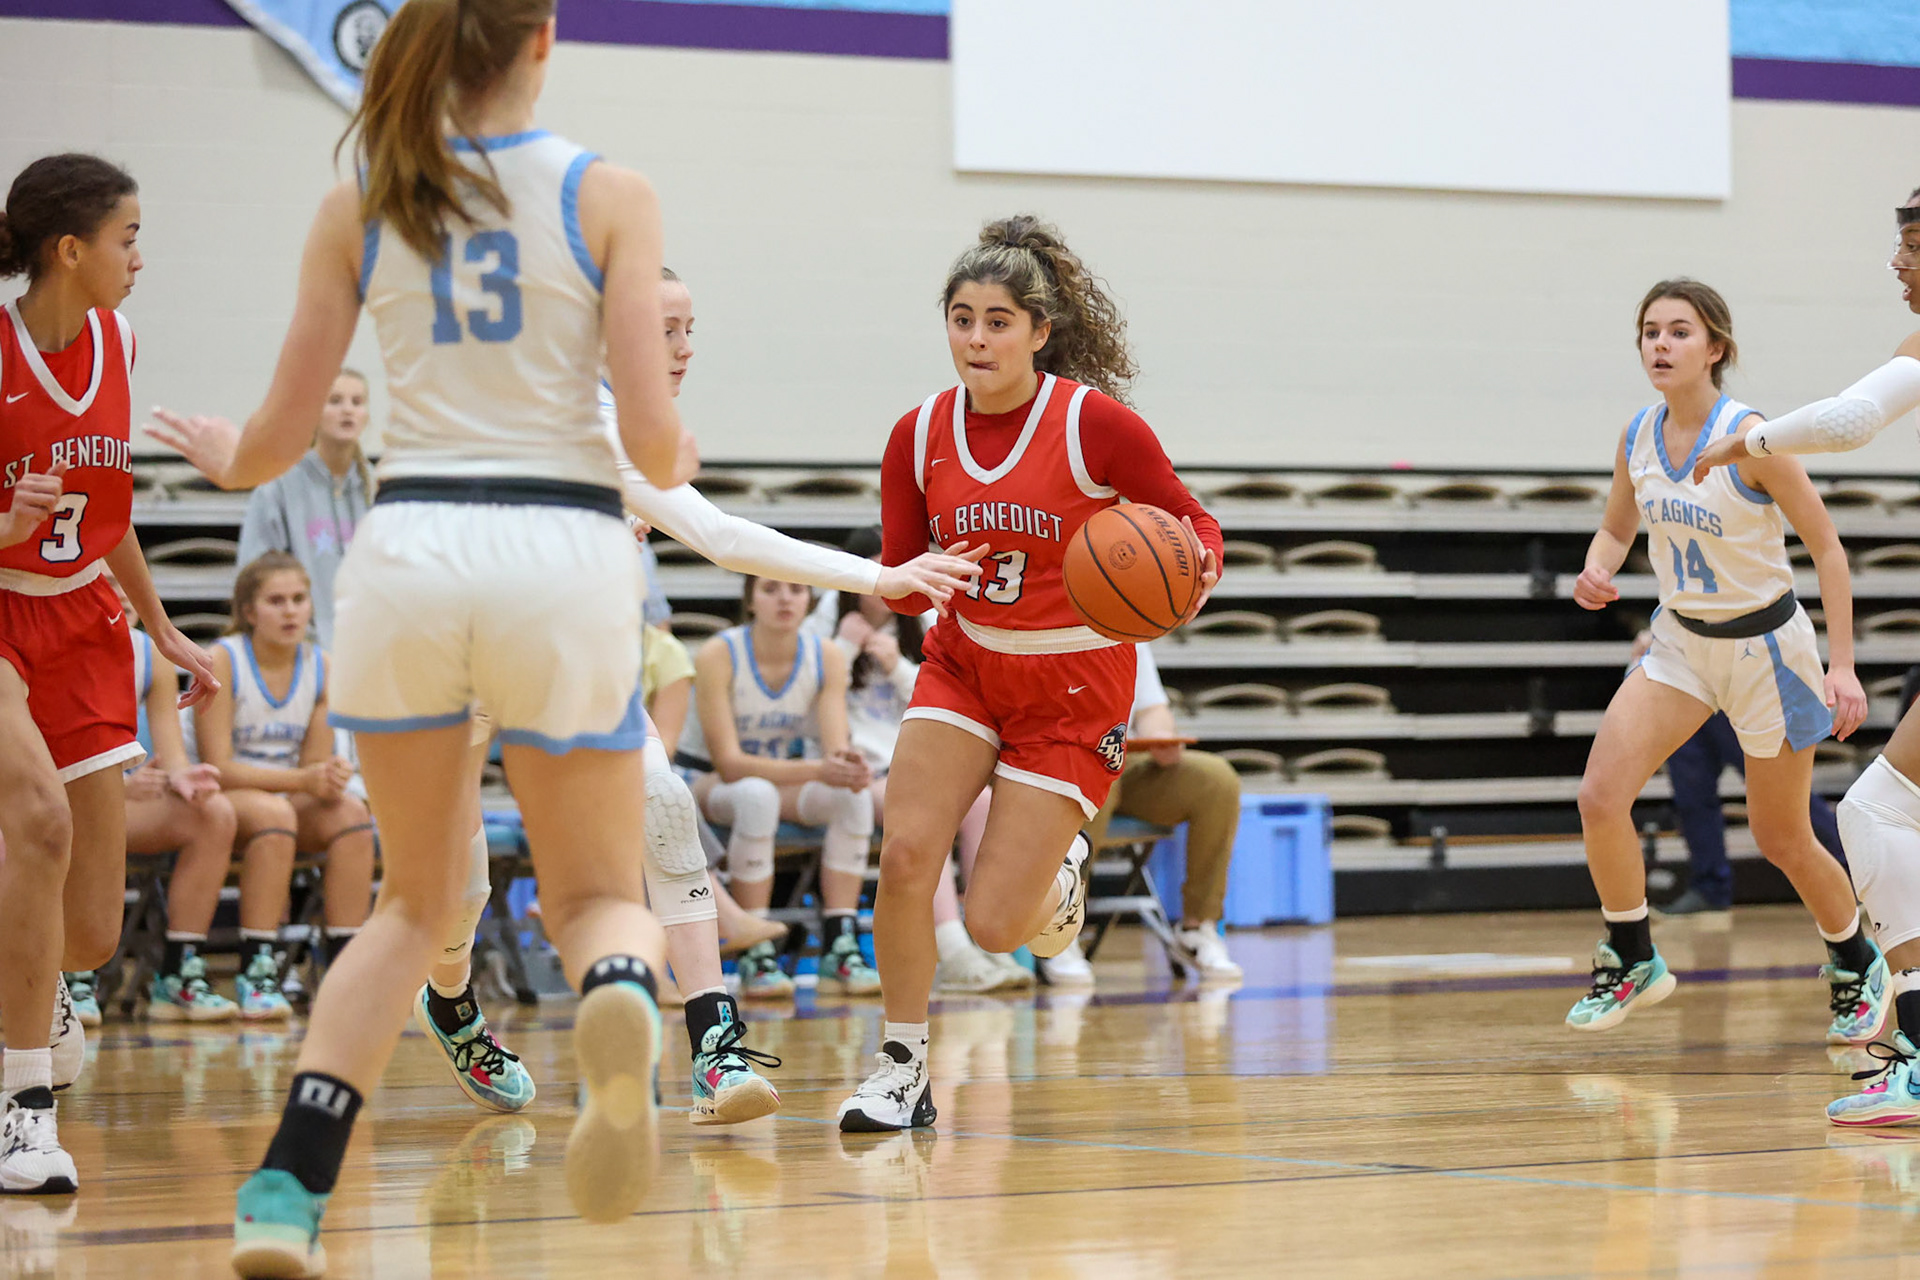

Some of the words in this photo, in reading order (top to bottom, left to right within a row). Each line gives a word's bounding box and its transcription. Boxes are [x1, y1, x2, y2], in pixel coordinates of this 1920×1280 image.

[430, 229, 523, 343] 13
[39, 491, 89, 563] 3
[955, 501, 1063, 543] BENEDICT
[1661, 498, 1723, 538] AGNES
[1667, 536, 1718, 593] 14
